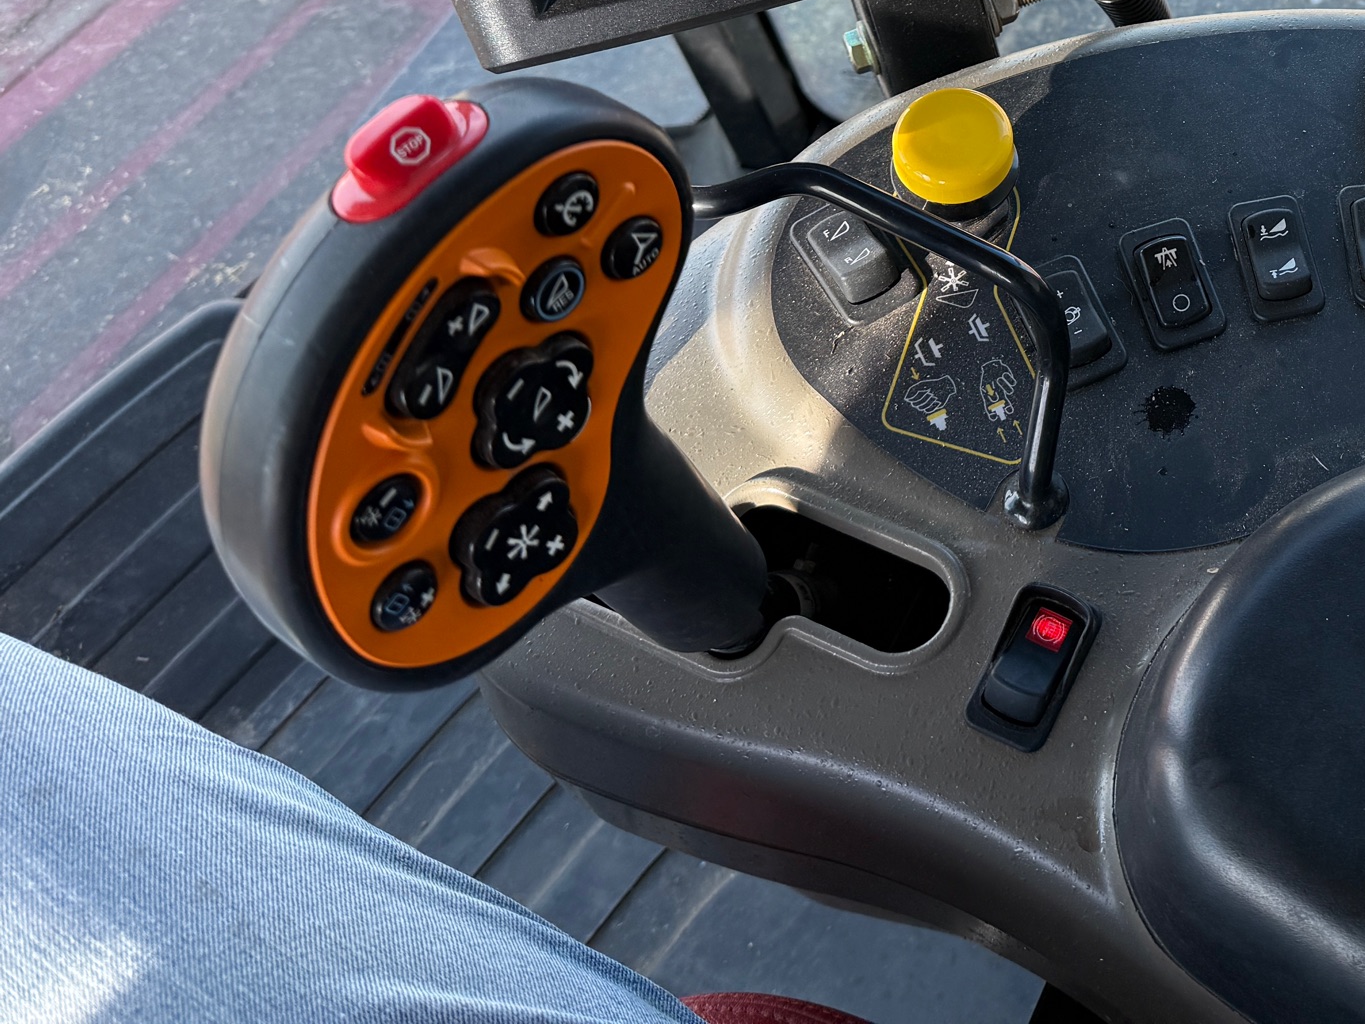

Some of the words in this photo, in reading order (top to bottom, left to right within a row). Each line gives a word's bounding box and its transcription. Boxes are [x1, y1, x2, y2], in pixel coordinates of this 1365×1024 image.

[397, 135, 424, 159] STOP
[823, 229, 831, 239] F
[632, 247, 660, 276] AUTO
